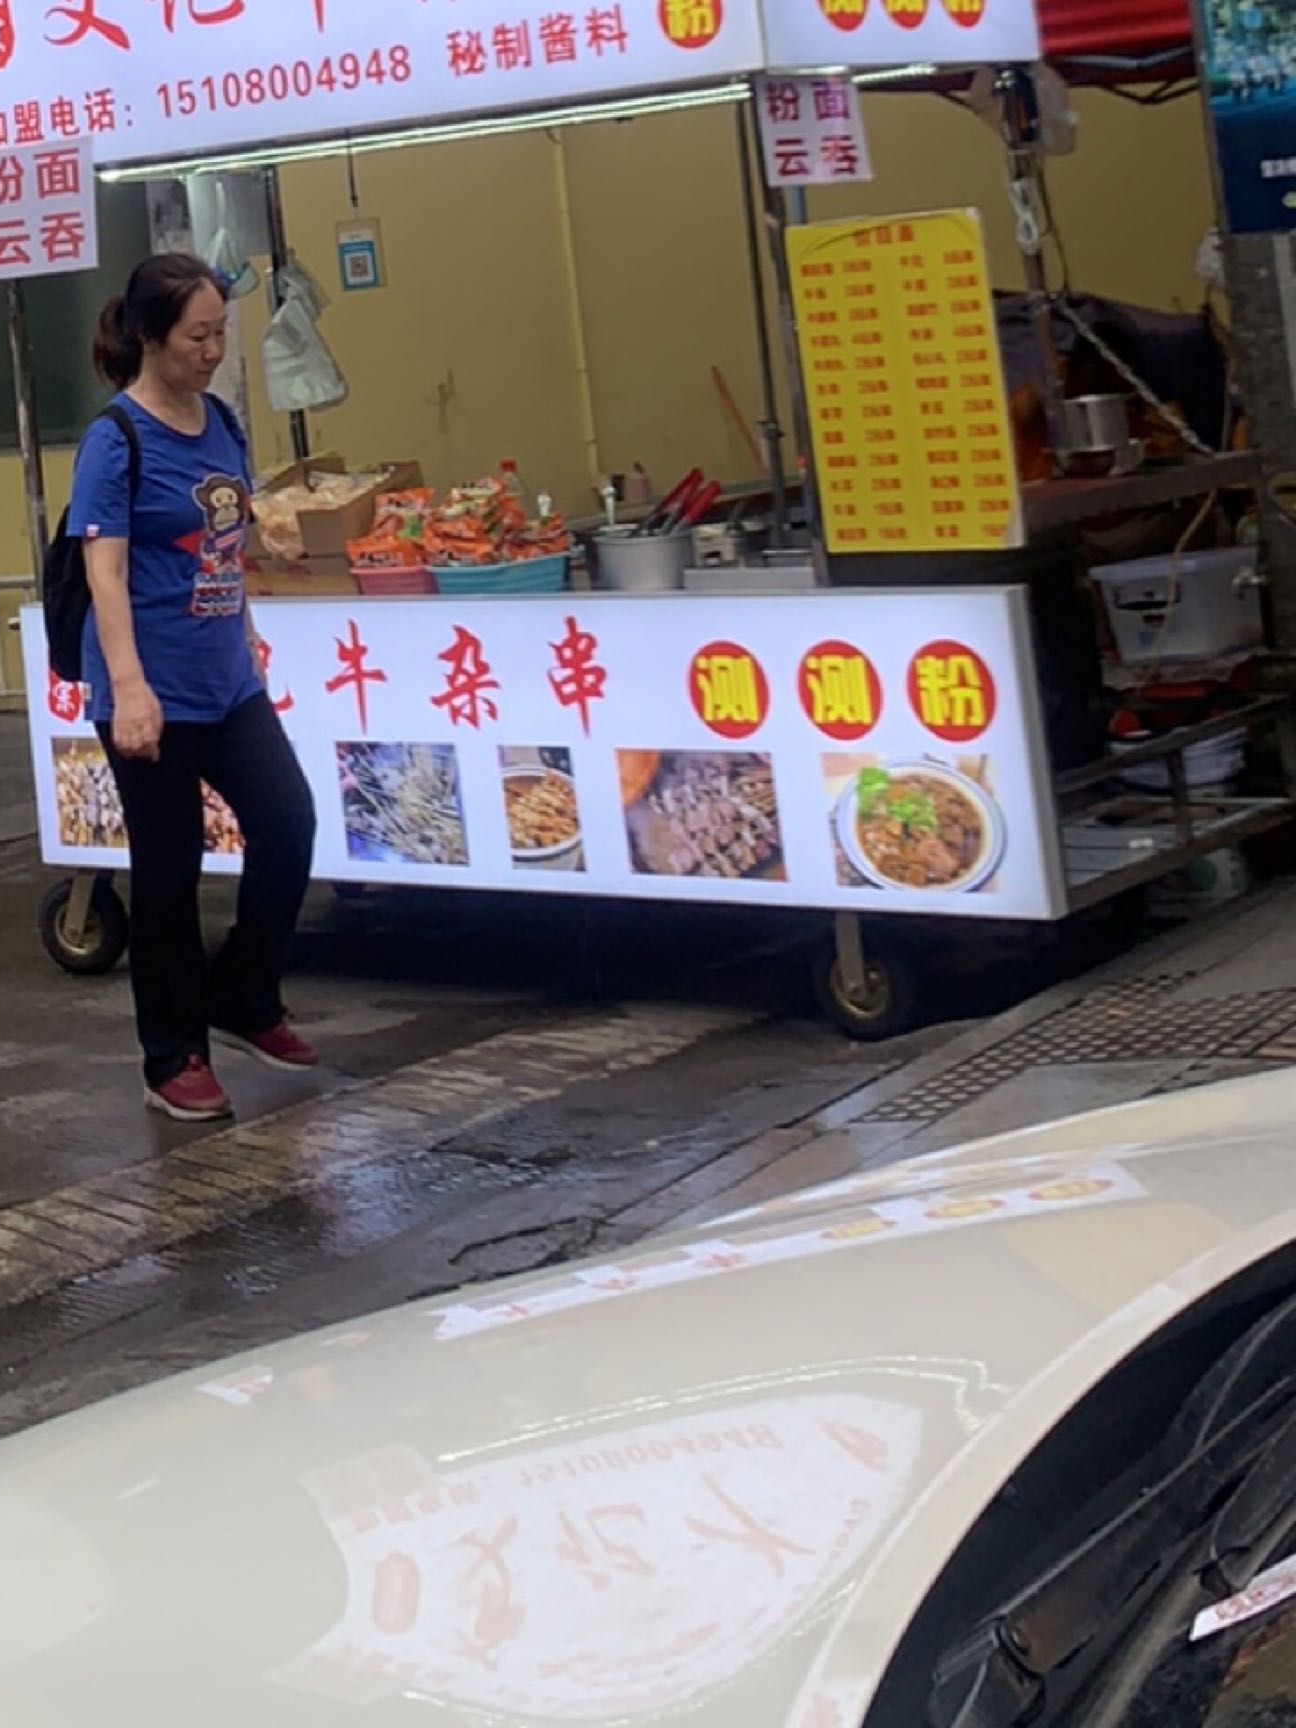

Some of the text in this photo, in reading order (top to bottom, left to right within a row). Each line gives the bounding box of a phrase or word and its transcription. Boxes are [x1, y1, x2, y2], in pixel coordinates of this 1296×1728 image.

[156, 44, 412, 118] 15108004948
[445, 5, 630, 77] 秘制酱料
[767, 79, 850, 122] 粉面
